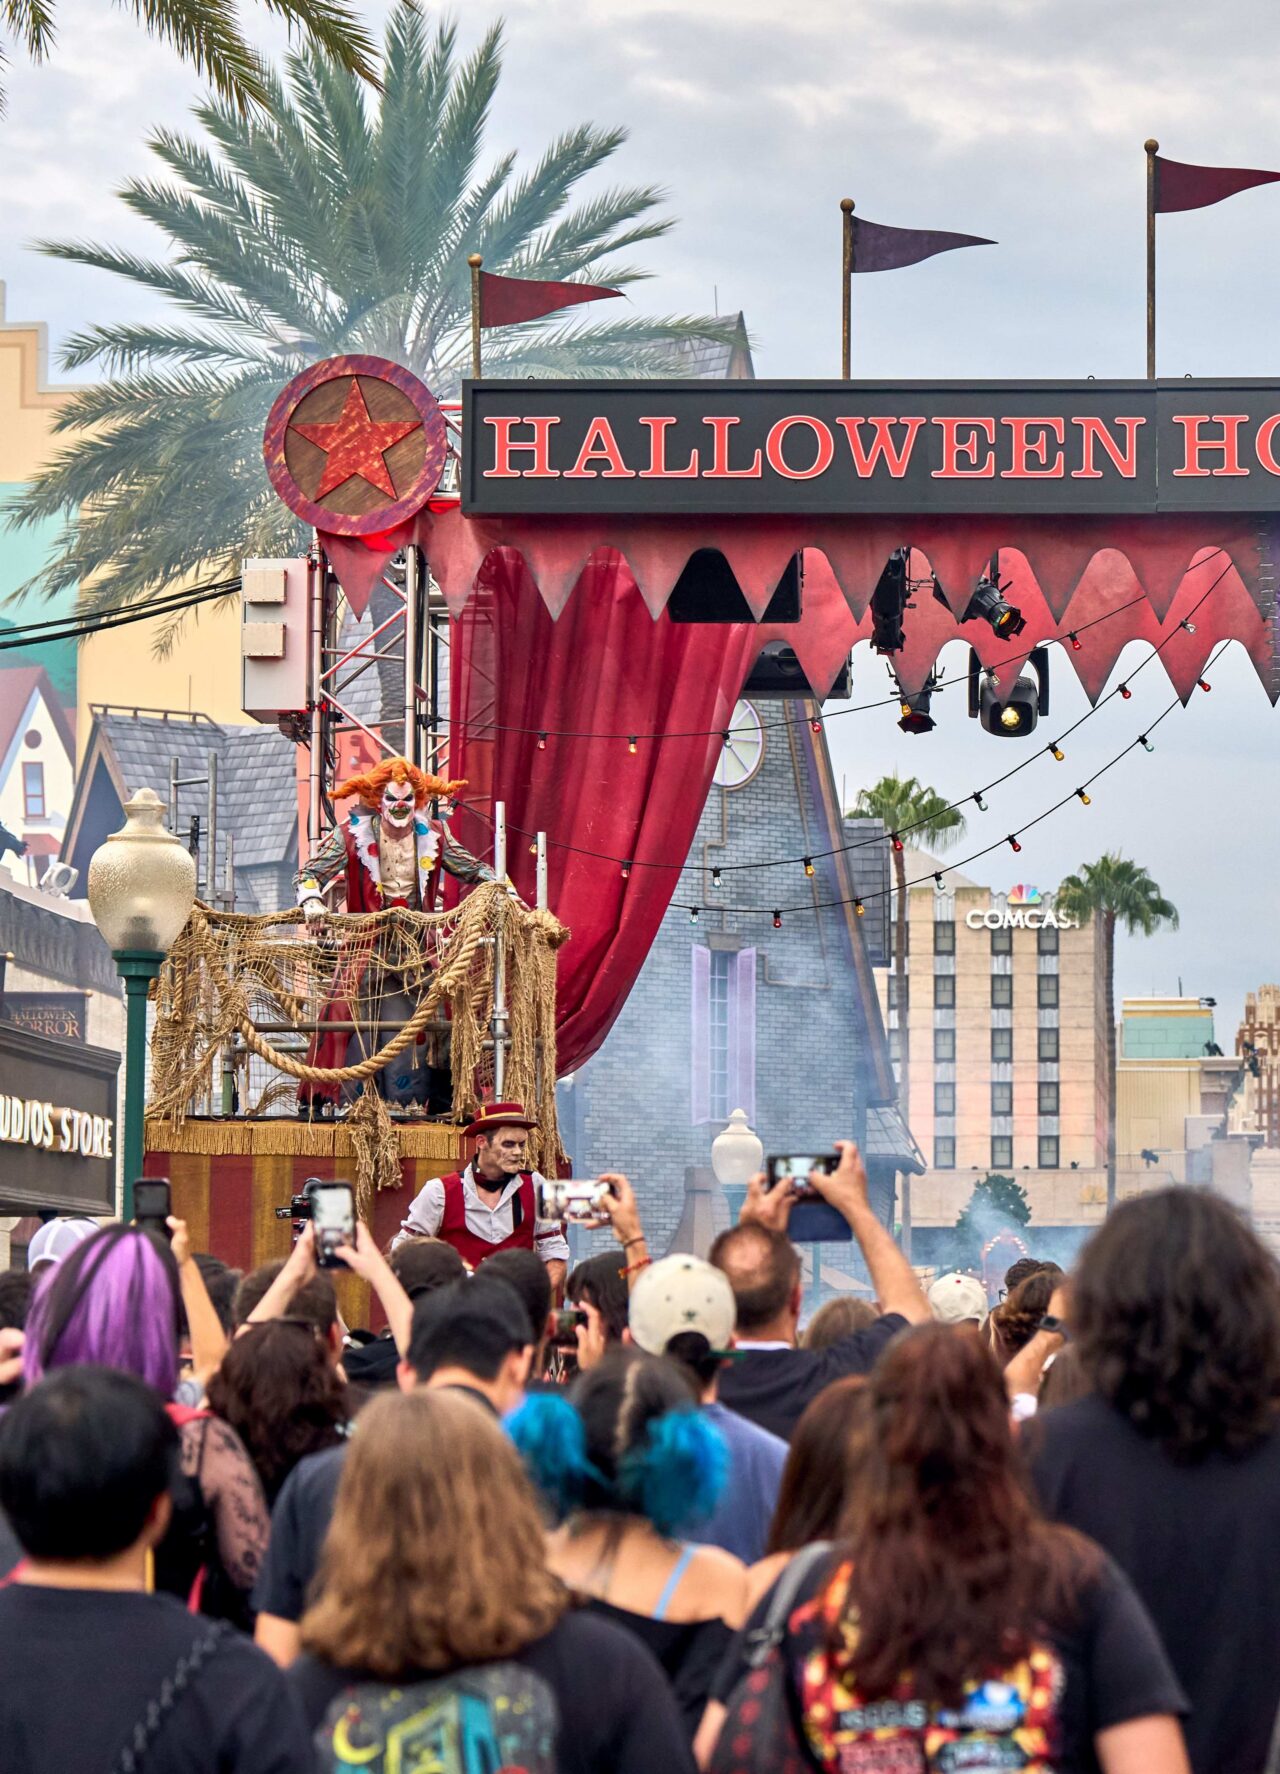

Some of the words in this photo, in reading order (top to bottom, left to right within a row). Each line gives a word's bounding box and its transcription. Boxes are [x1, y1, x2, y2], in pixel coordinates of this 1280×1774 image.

[482, 415, 1146, 480] HALLOWEEN
[966, 909, 1080, 929] COMCAS
[10, 1008, 76, 1020] HALLOWEEN
[61, 1107, 113, 1158] STORE
